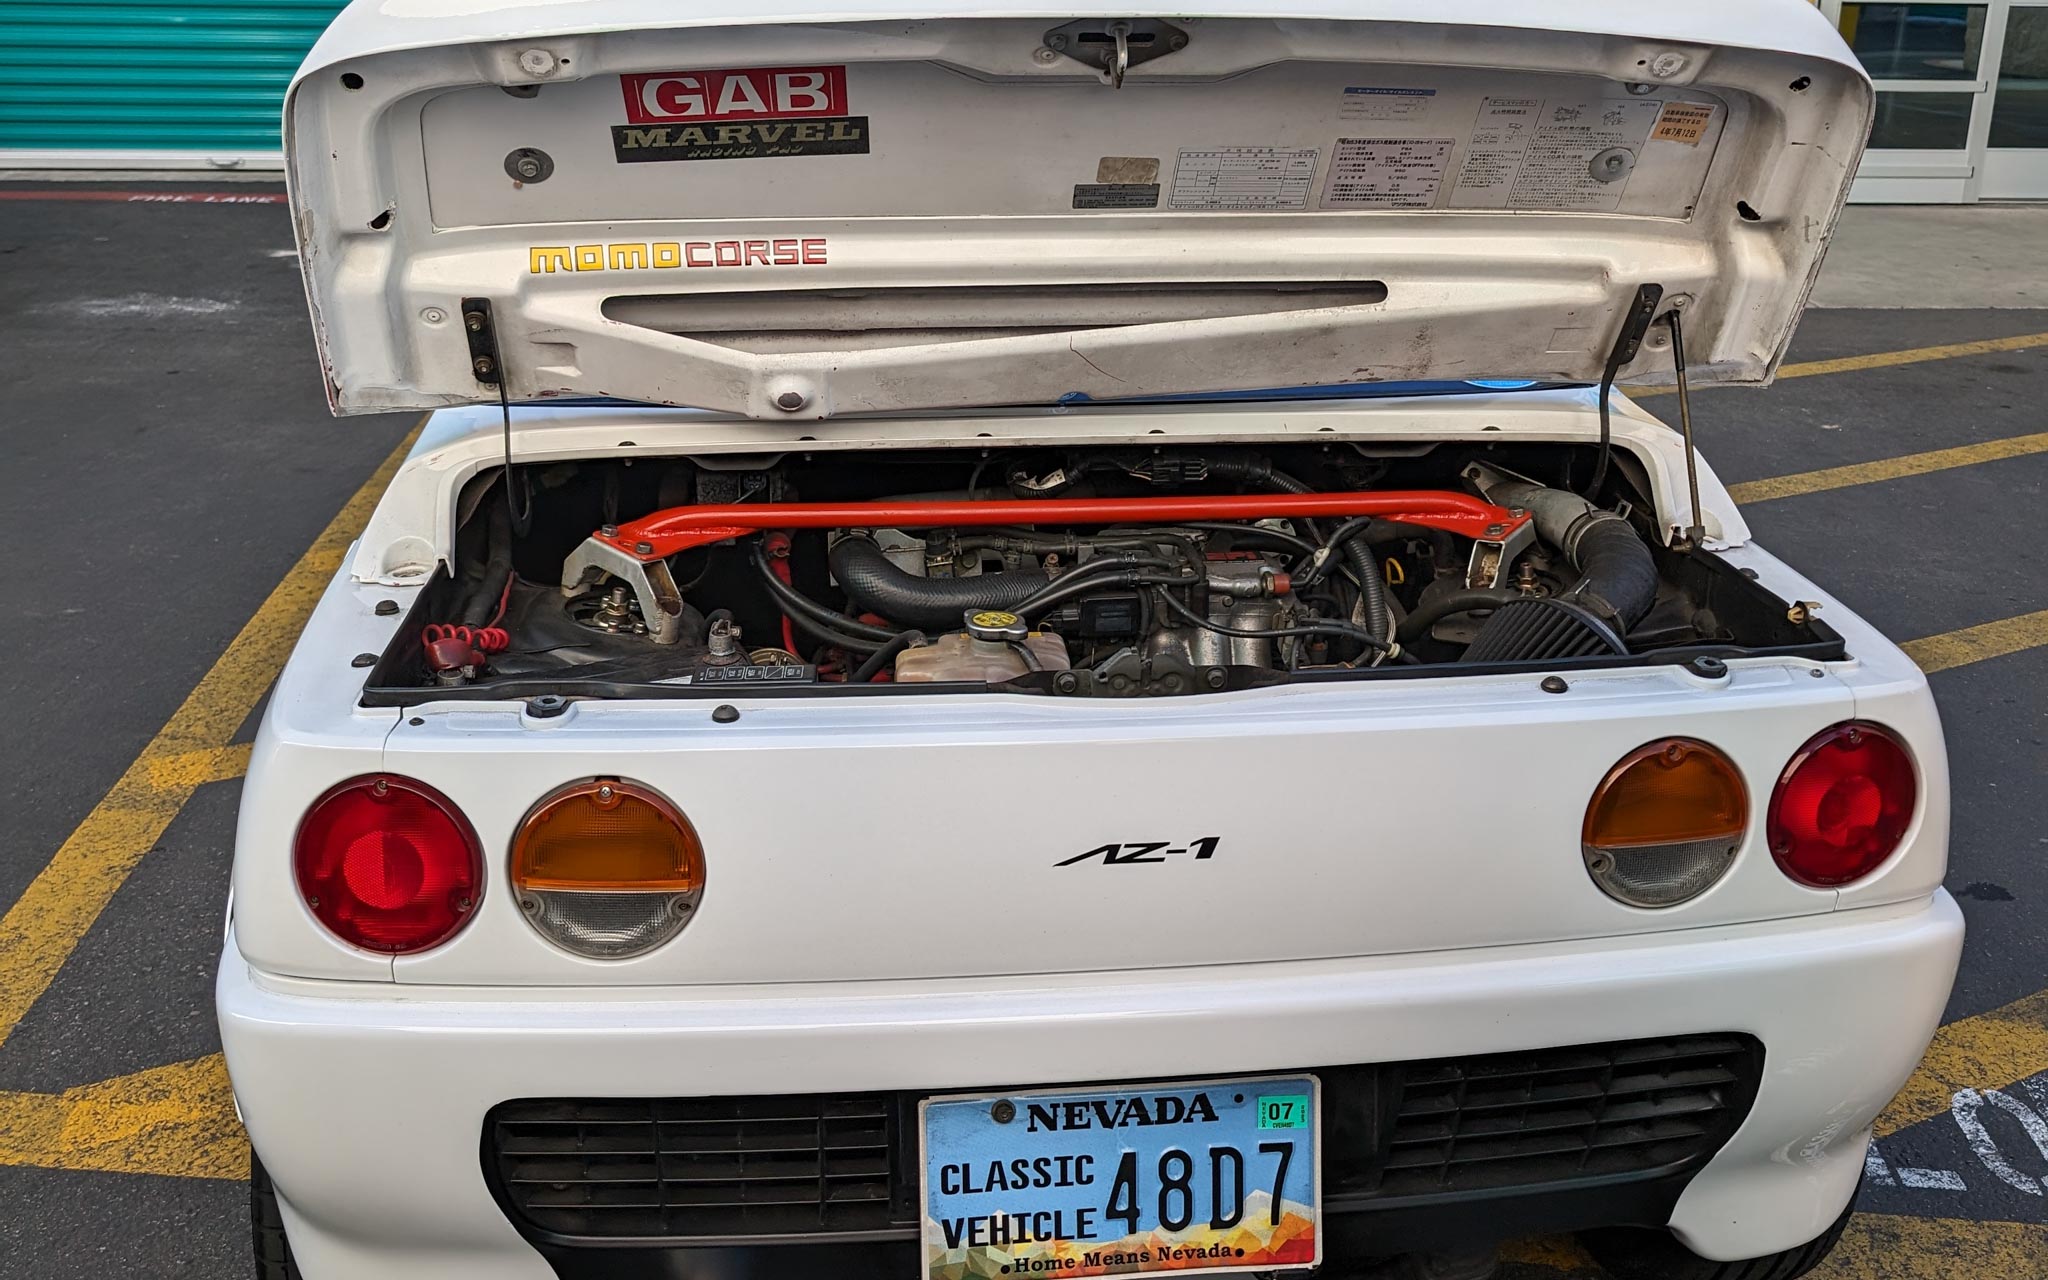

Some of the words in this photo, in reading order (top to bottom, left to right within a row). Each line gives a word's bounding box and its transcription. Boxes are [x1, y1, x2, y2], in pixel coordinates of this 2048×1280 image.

[642, 72, 830, 118] GAB
[622, 121, 861, 149] MARVEL
[203, 195, 276, 204] LANE
[1052, 836, 1221, 867] AZ-1
[1027, 1093, 1219, 1133] NEVADA
[1268, 1102, 1294, 1121] 07
[940, 1154, 1095, 1196] CLASSIC
[1105, 1141, 1294, 1235] 48D7
[941, 1207, 1098, 1250] VEHICLE
[1013, 1256, 1080, 1274] Home
[1083, 1249, 1150, 1268] Means
[1157, 1242, 1233, 1262] Nevada
